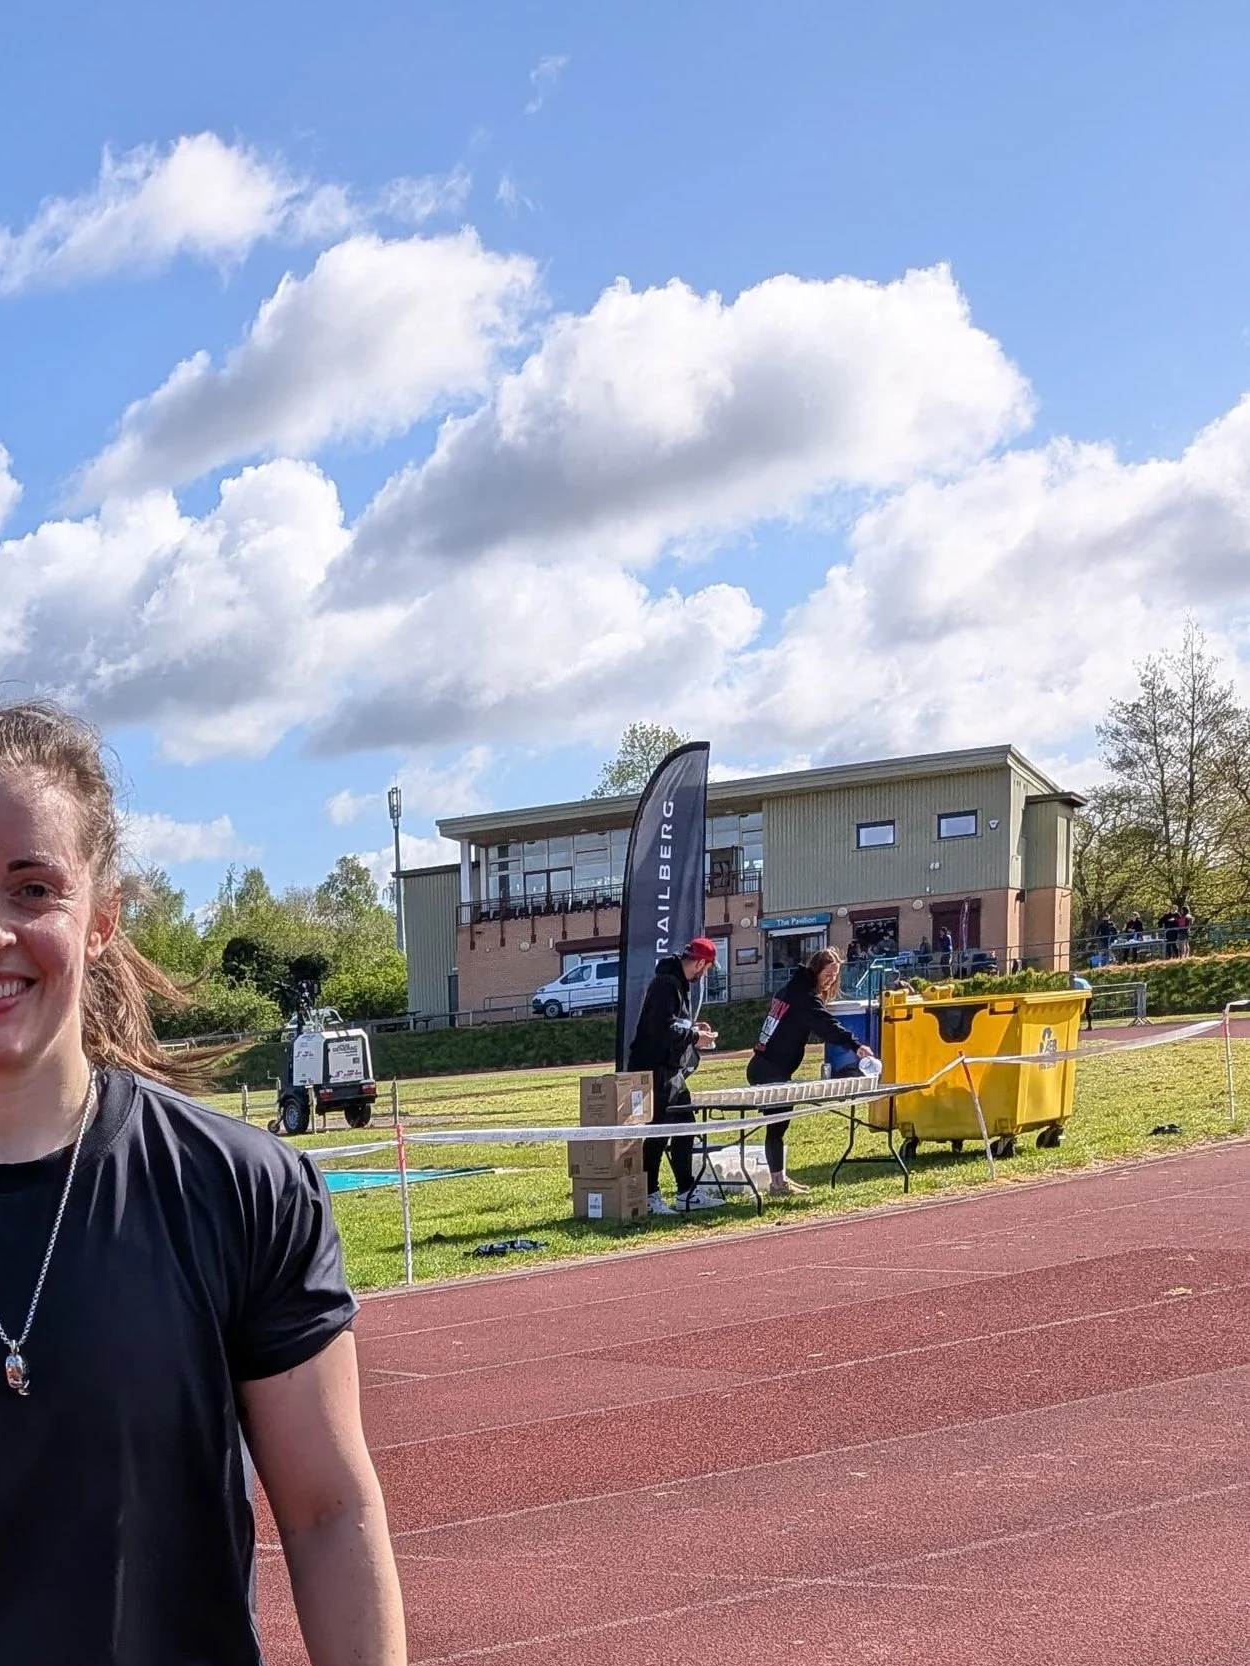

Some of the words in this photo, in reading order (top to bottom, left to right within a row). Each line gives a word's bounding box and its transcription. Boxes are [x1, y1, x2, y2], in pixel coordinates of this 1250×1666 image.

[653, 800, 674, 969] RAILBERG
[776, 919, 790, 927] The
[791, 917, 817, 926] Pavilion
